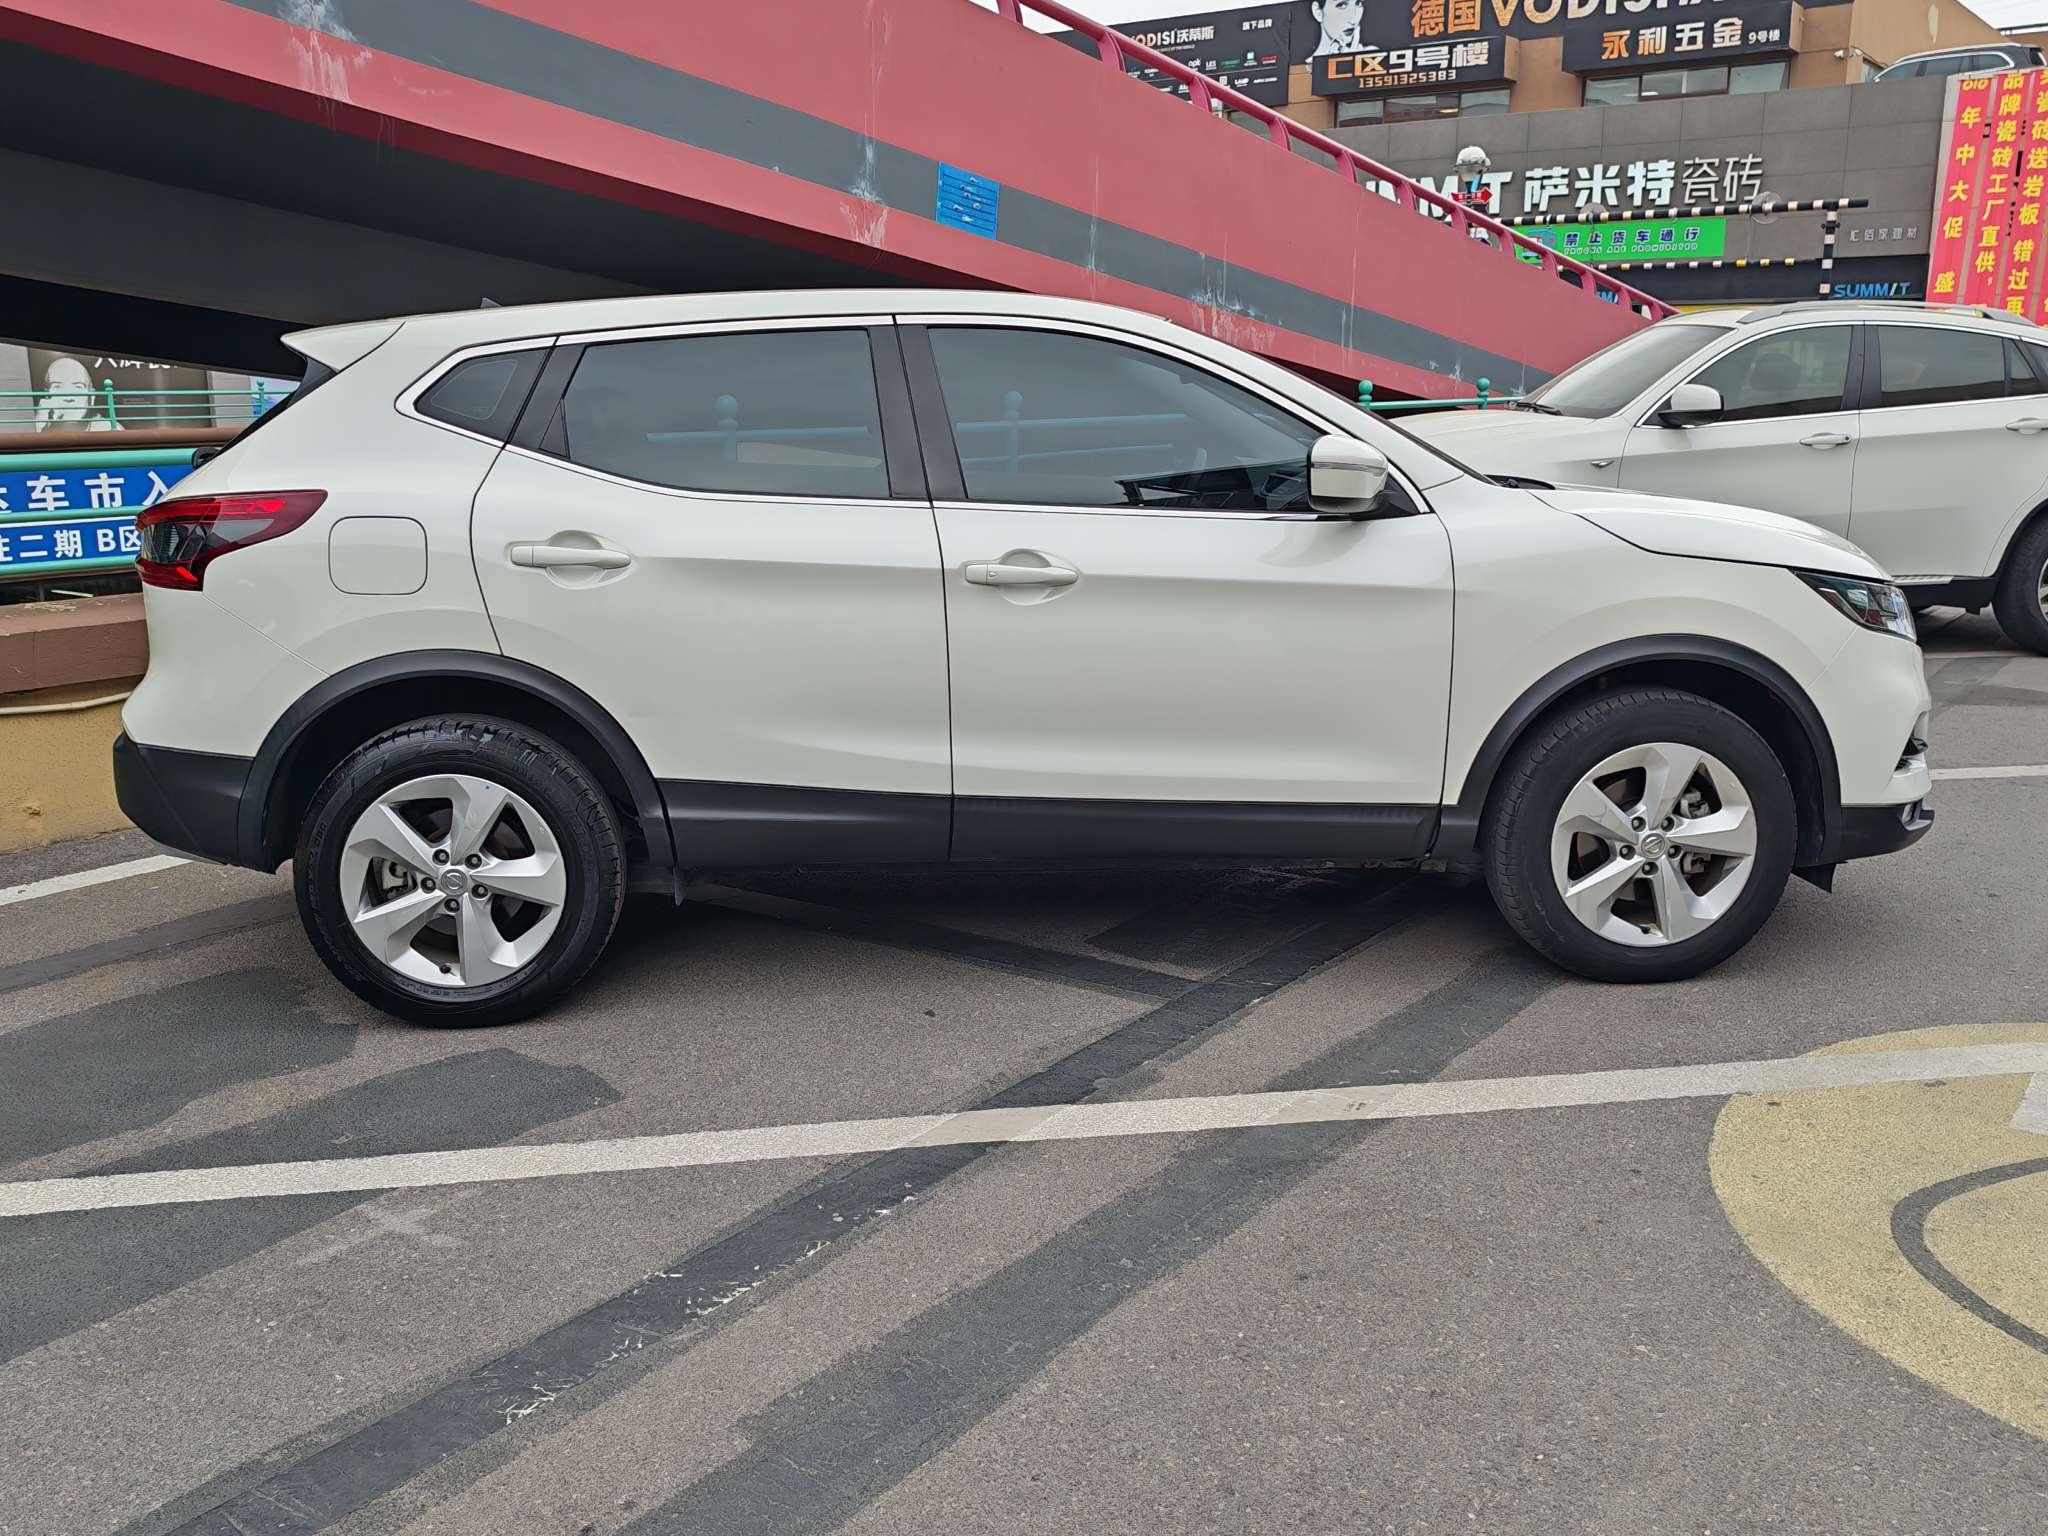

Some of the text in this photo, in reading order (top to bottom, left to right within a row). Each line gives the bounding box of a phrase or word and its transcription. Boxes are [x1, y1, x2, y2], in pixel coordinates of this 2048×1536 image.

[1411, 0, 1481, 38] 德国
[1601, 17, 1780, 60] 永利五金 9号楼
[1327, 41, 1489, 79] C区9号楼
[1359, 70, 1457, 88] 13591325383
[1523, 153, 1763, 212] 萨米特瓷砖
[1564, 228, 1699, 247] 禁止货车通行
